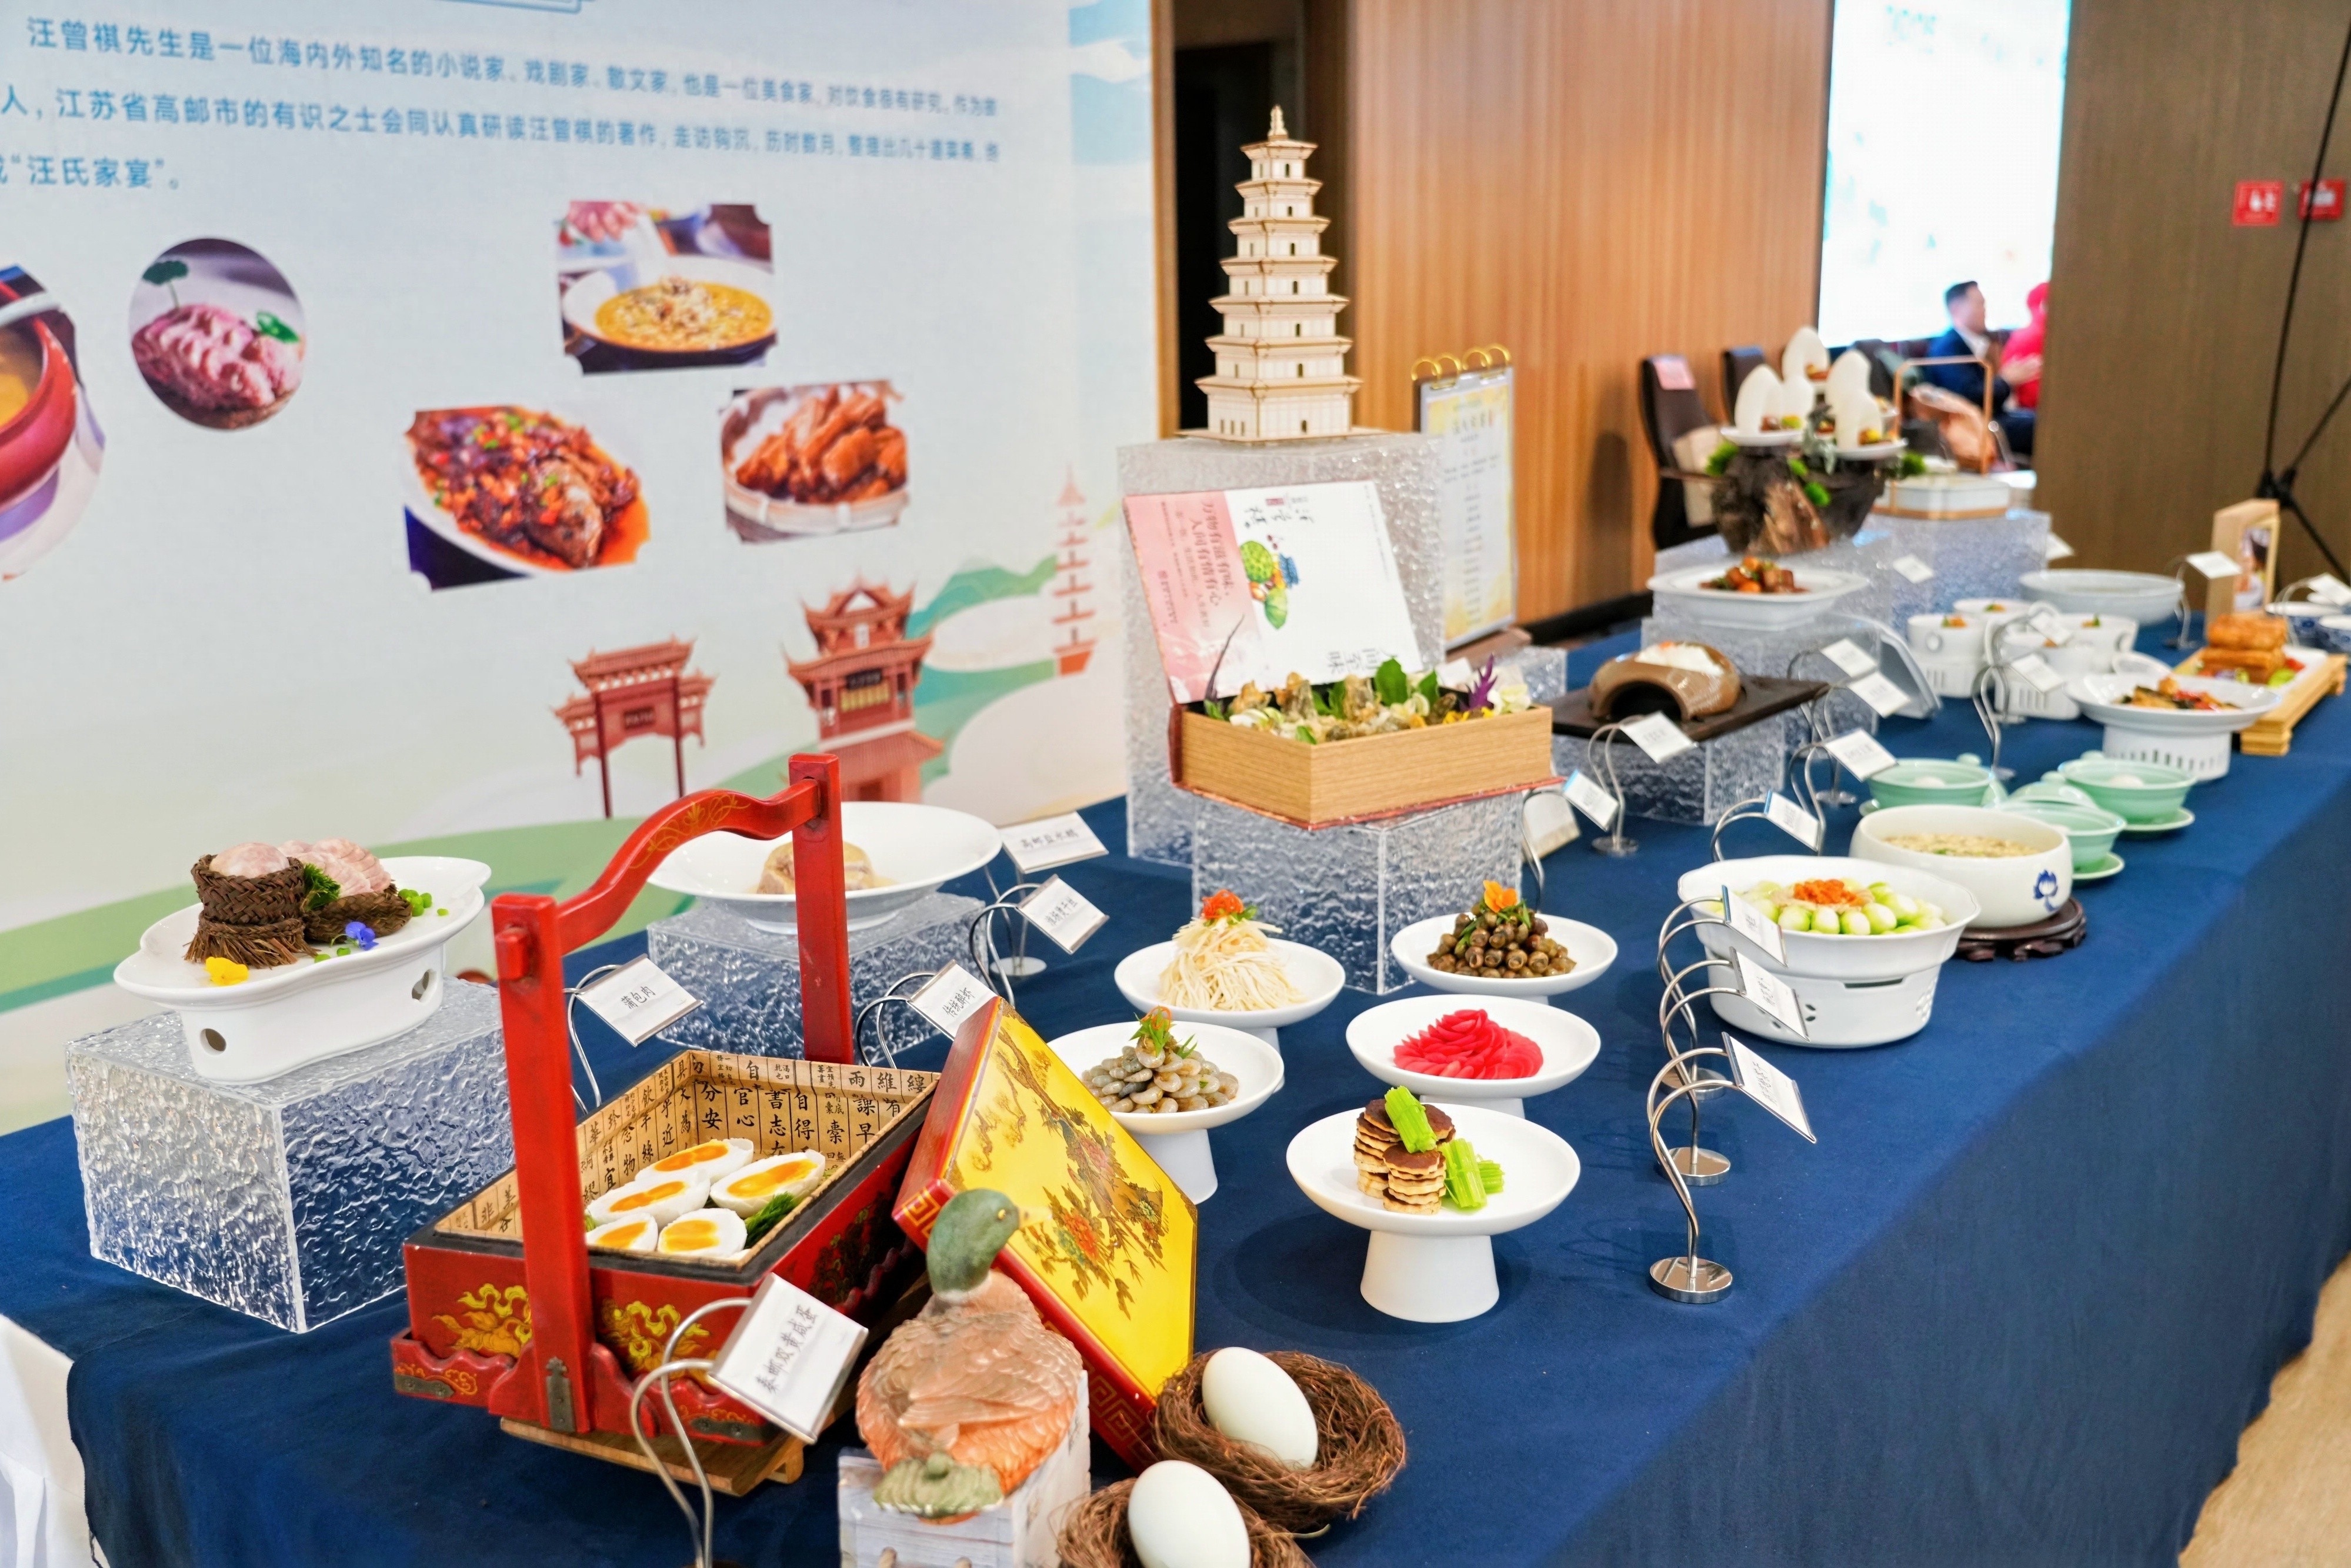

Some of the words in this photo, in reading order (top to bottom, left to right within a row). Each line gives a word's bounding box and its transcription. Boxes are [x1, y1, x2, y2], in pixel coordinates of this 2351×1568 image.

[621, 986, 656, 1009] 蒲包肉
[942, 987, 975, 1019] 传统醉虾
